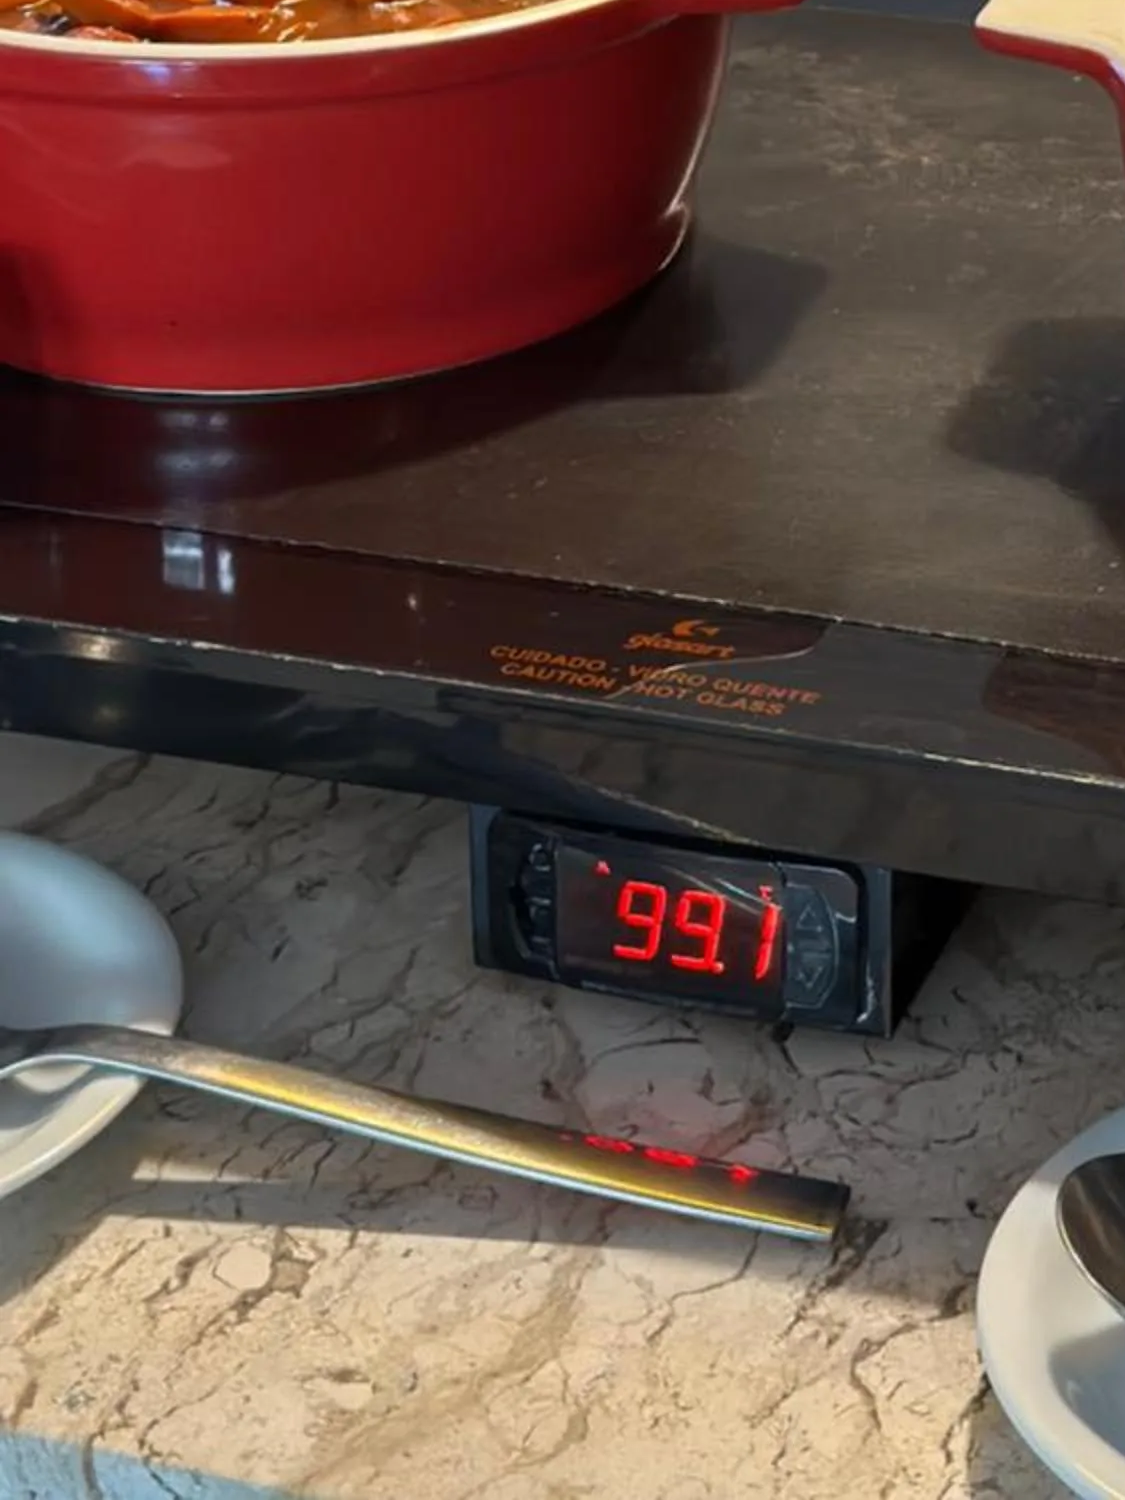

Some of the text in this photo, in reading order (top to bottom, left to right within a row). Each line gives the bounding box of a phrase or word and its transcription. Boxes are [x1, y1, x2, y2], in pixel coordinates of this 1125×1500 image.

[490, 645, 608, 673] CUIDADO
[628, 664, 707, 688] VIDRO
[712, 677, 822, 705] QUENTE
[500, 662, 787, 716] CAUTION HOT GLASS
[613, 880, 779, 980] 99.1
